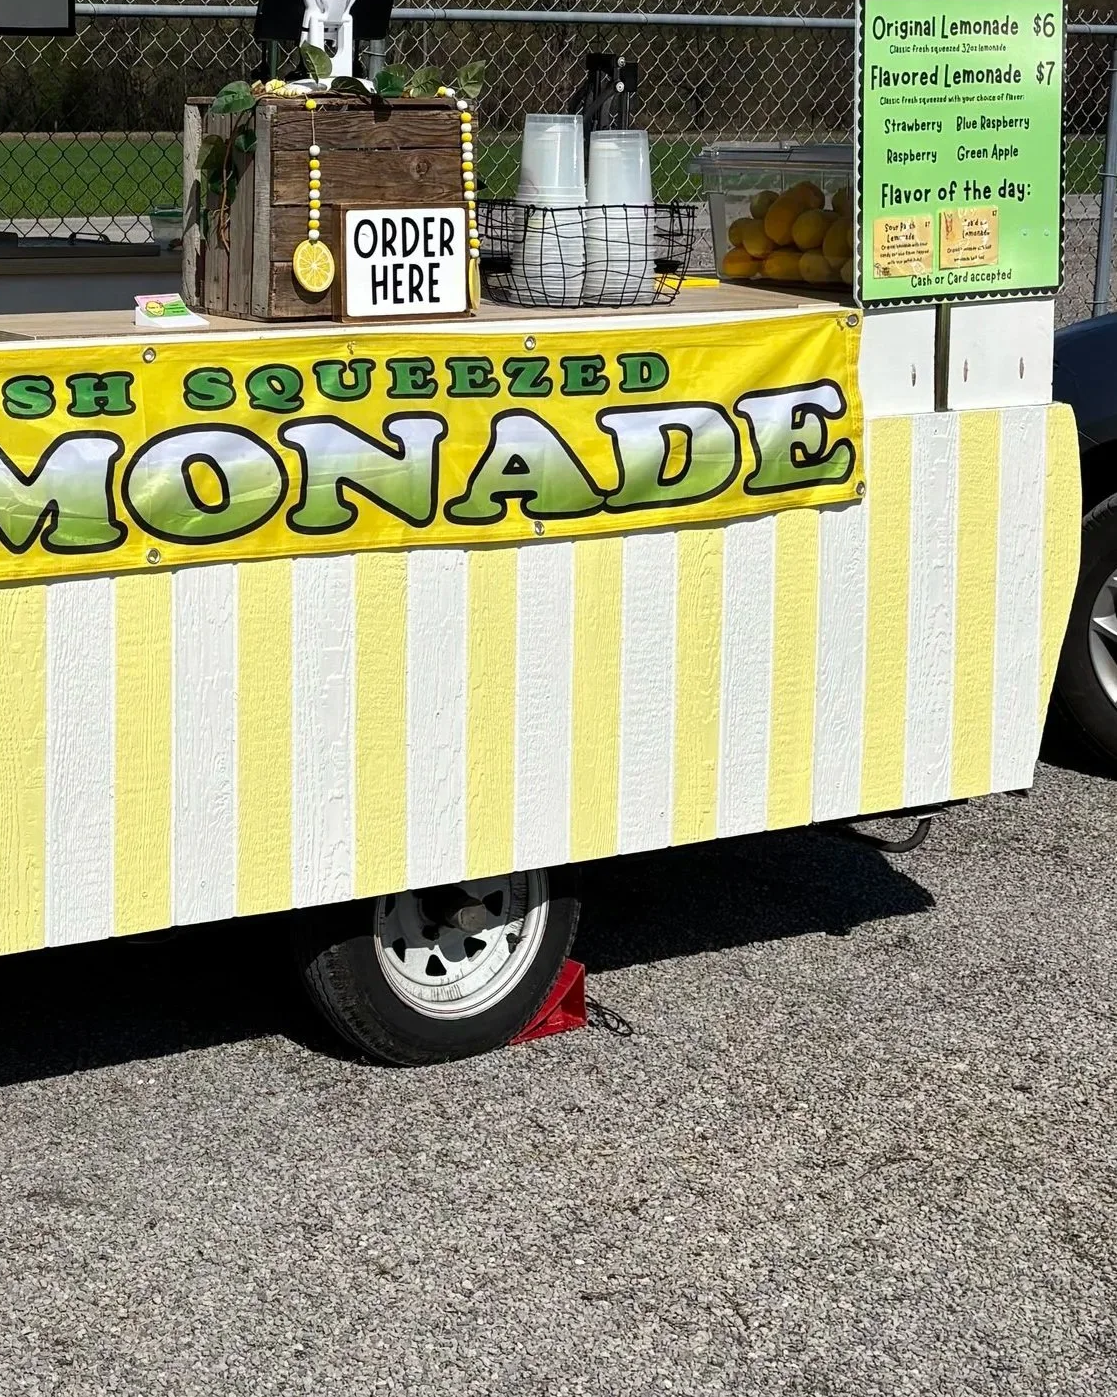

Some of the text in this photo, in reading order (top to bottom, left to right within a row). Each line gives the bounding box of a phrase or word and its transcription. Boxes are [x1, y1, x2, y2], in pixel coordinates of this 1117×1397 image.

[872, 13, 1055, 40] Original Lemonade $6
[889, 44, 911, 54] Classic
[912, 44, 930, 53] fresh
[930, 44, 960, 54] squeezed
[978, 44, 1006, 52] lemonade
[871, 61, 1056, 90] Flavored Lemonade $7
[880, 96, 900, 105] Classic
[901, 96, 918, 104] fresh
[918, 95, 947, 105] squeezed
[948, 95, 961, 103] with
[962, 95, 976, 104] your
[976, 94, 996, 102] choice
[997, 93, 1005, 101] of
[884, 118, 942, 134] Strawberry
[956, 115, 1030, 131] Blue Raspberry
[886, 148, 937, 165] Raspberry
[957, 144, 1019, 161] Green Apple
[881, 178, 1031, 208] Flavor of the day:
[900, 221, 916, 232] Pach
[354, 217, 455, 259] ORDER
[887, 233, 915, 243] Lemade
[371, 262, 441, 305] HERE
[911, 269, 1012, 288] Cash or Card accepted
[183, 353, 671, 415] SQUEEZED
